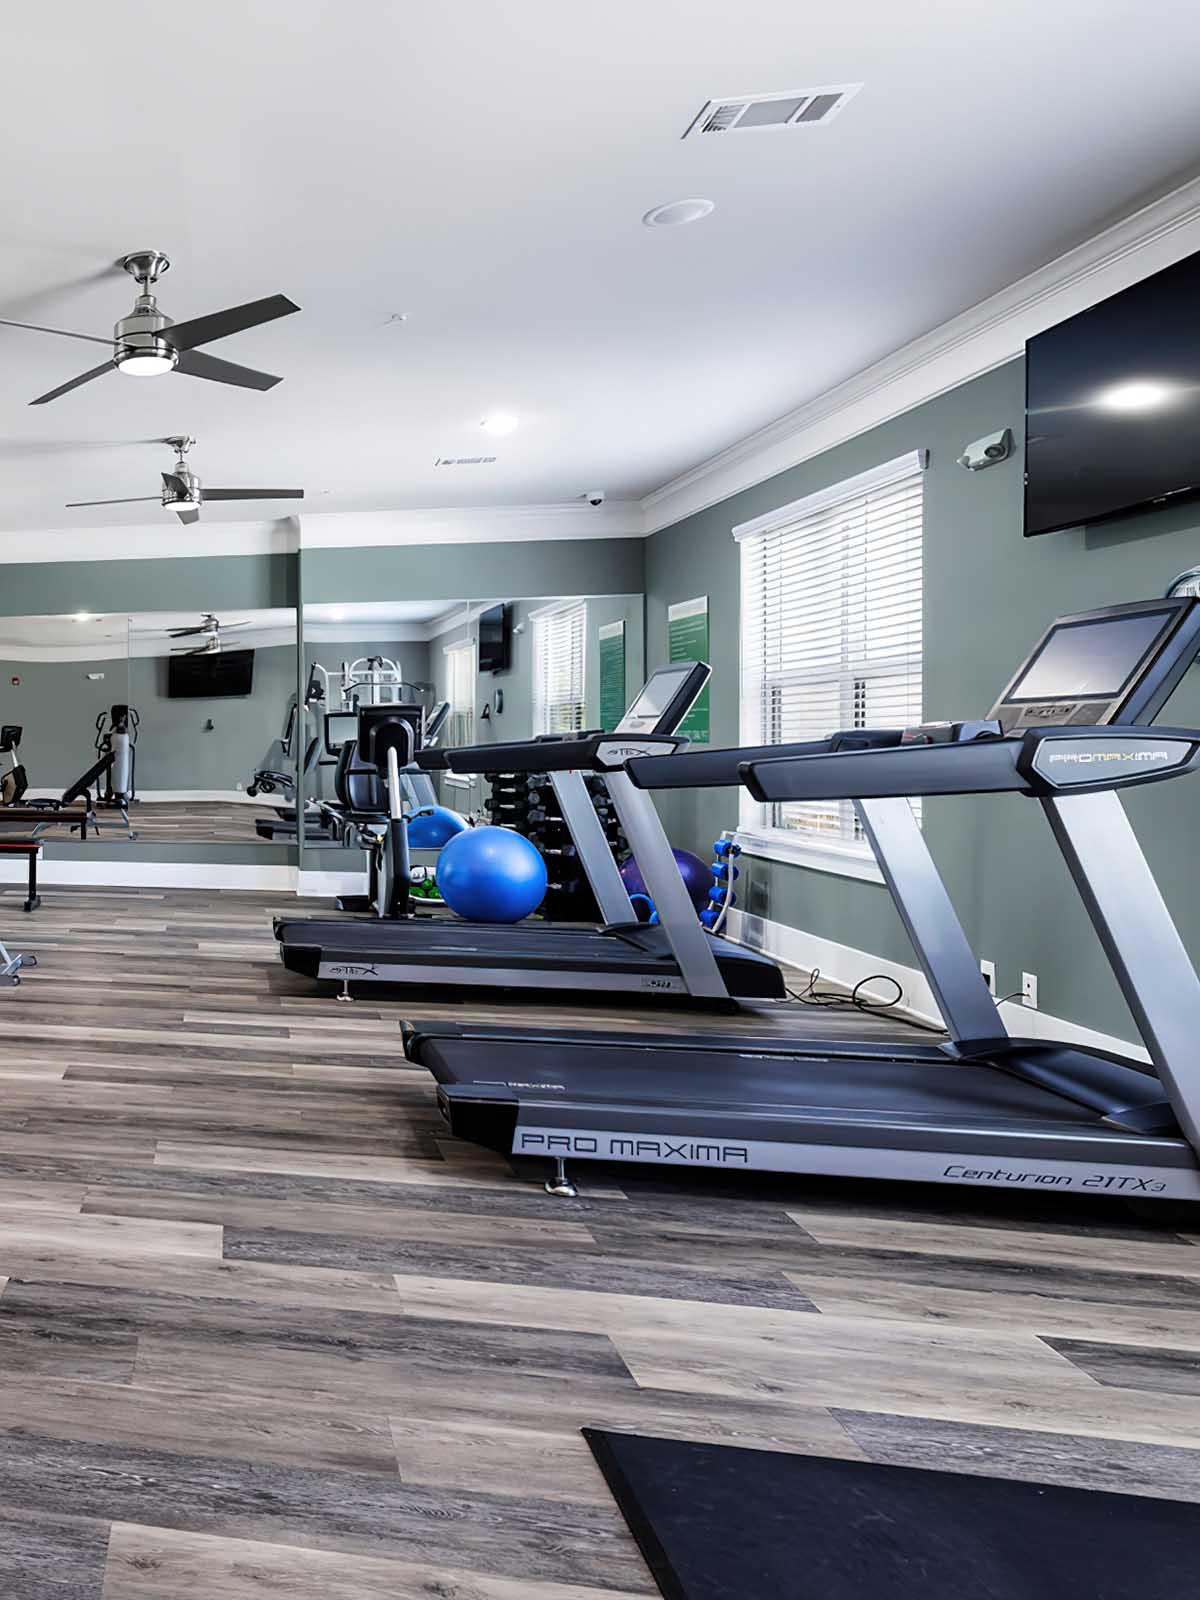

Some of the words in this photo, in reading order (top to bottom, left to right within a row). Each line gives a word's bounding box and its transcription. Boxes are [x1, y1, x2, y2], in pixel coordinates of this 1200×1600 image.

[1049, 751, 1168, 763] PROMAXIMA
[521, 1133, 597, 1153] PRO
[609, 1139, 748, 1163] MAXIMA
[943, 1165, 1072, 1186] Centurion
